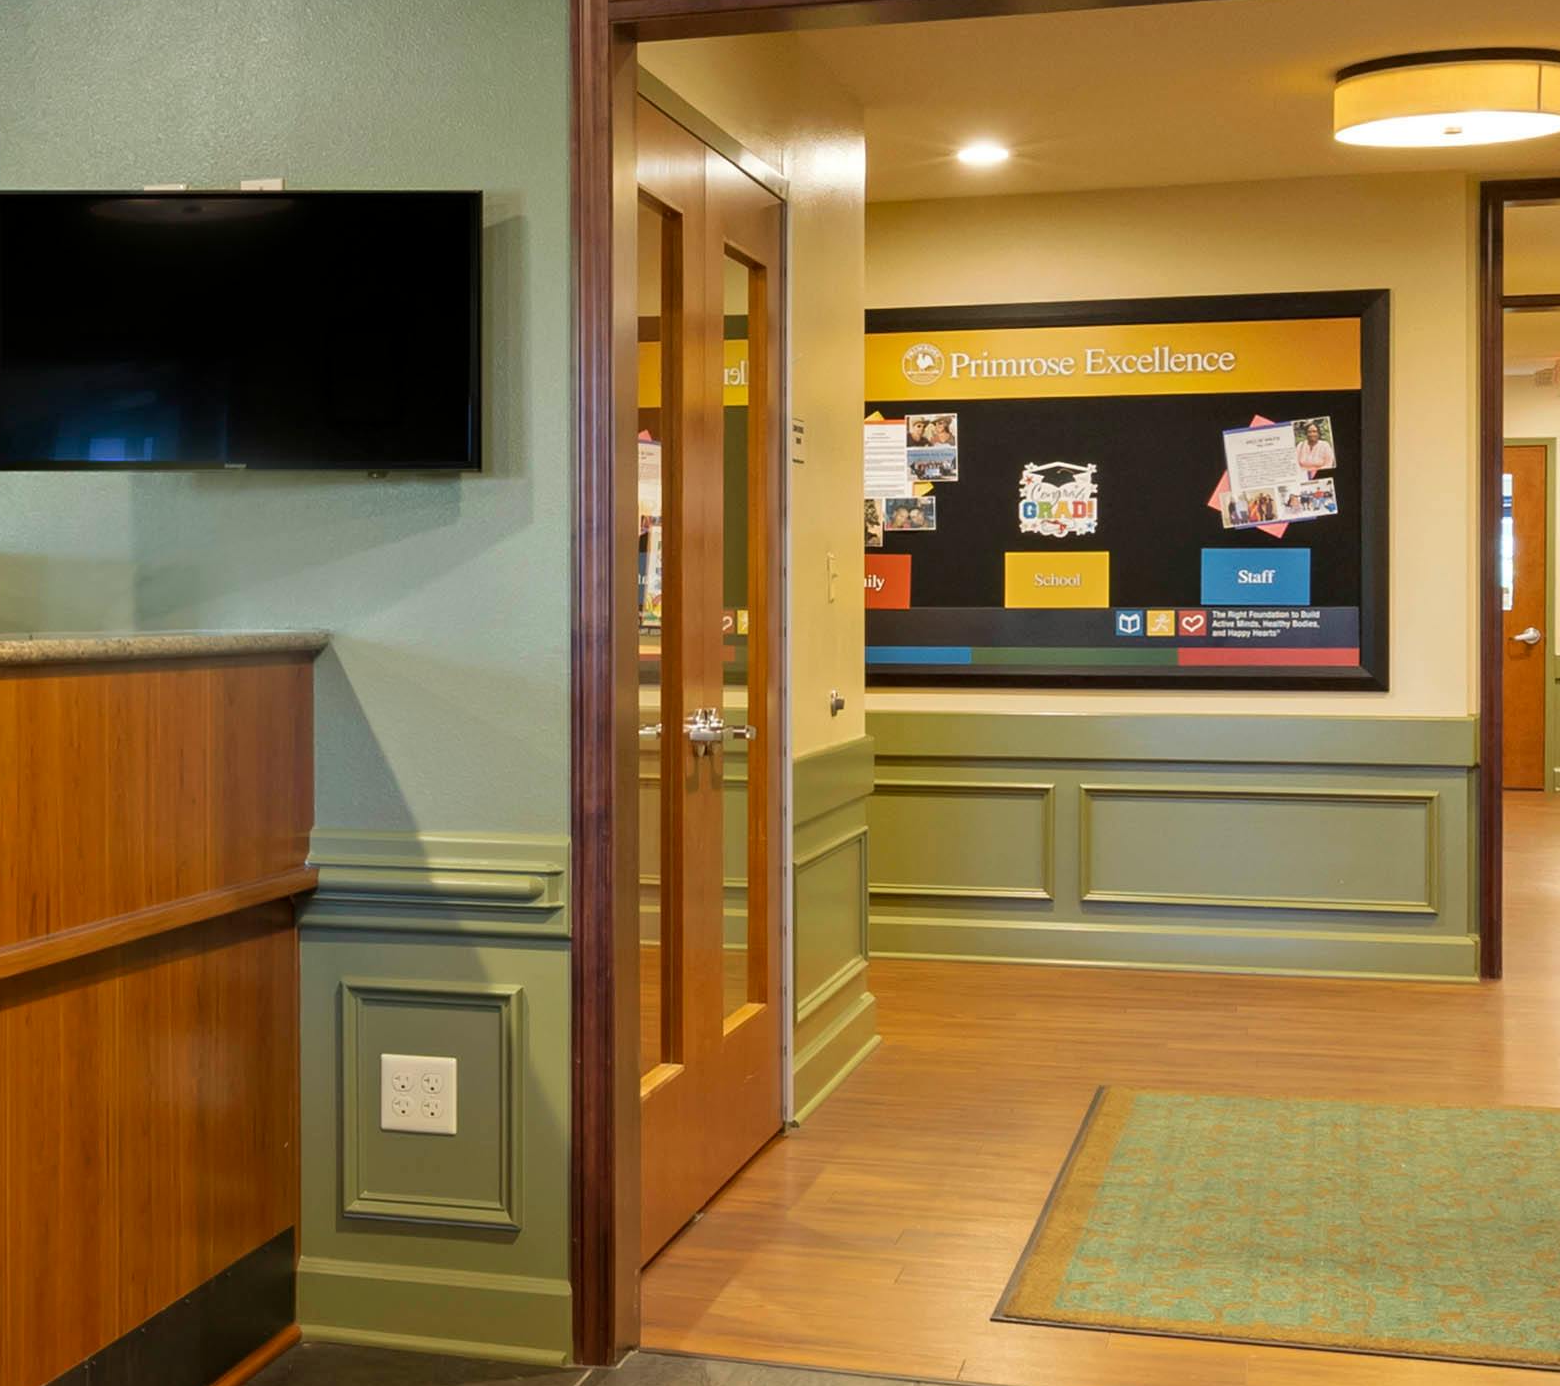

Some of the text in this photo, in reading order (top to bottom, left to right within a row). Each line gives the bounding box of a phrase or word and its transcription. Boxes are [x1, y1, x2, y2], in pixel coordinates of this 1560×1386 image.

[950, 351, 1075, 379] Primrose
[1085, 346, 1235, 375] Excellence
[1023, 501, 1094, 519] GRAD!
[1034, 572, 1082, 588] School
[1238, 569, 1276, 584] Staff
